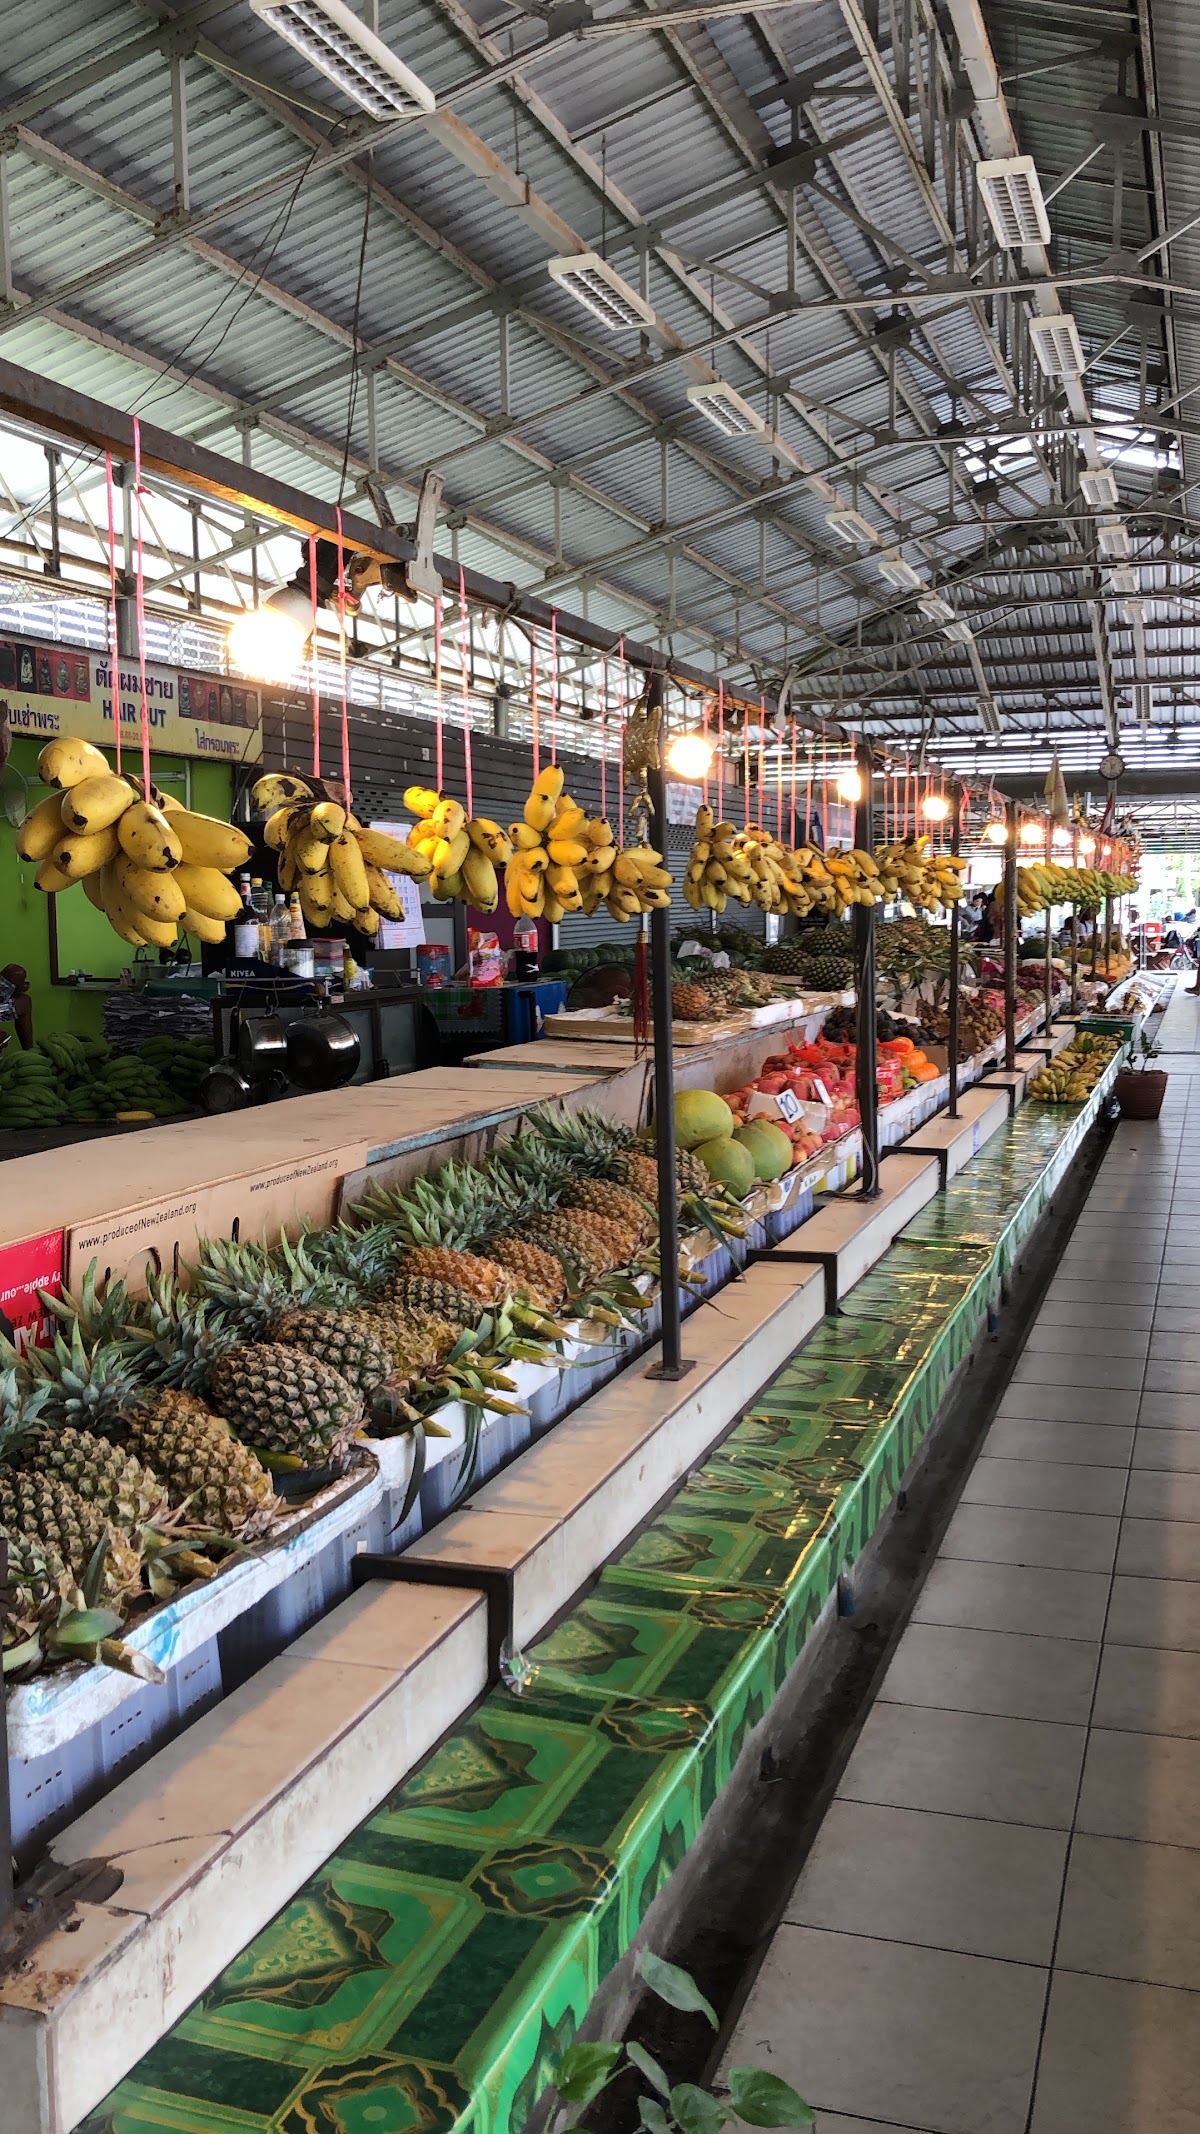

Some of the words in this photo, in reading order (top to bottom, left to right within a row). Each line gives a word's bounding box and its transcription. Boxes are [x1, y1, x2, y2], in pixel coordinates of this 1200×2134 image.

[102, 699, 137, 724] HIR
[230, 970, 256, 978] NIVEA
[249, 1159, 339, 1192] www.produceofNewZealand.org
[78, 1203, 197, 1250] www.produceofNewZealand.org
